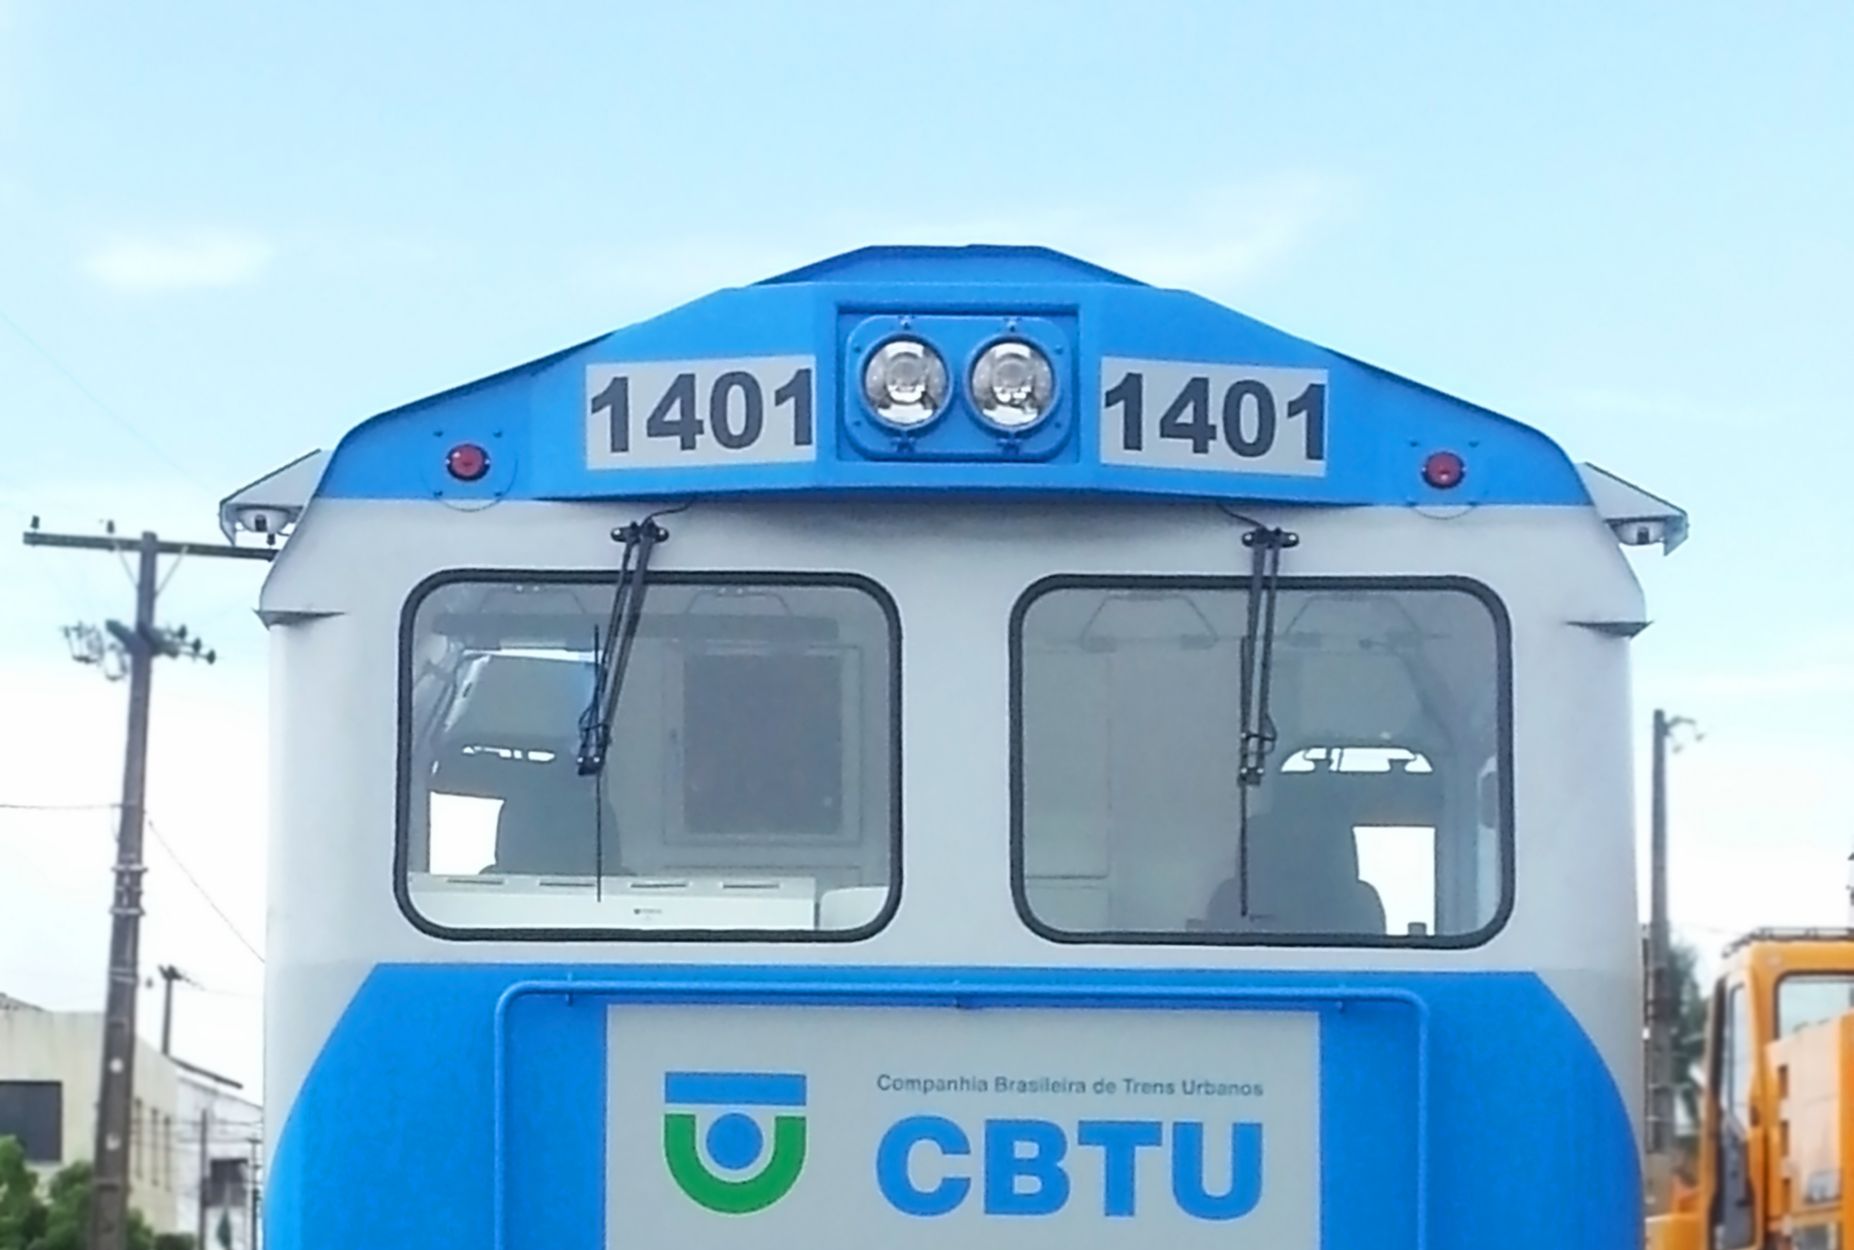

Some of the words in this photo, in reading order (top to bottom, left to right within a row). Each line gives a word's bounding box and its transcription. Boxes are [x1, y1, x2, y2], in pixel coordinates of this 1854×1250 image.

[590, 366, 814, 455] 1401
[1104, 369, 1326, 462] 1401
[876, 1073, 989, 1095] Companhia
[995, 1075, 1087, 1095] Brasileira
[1092, 1077, 1117, 1095] de
[1122, 1077, 1176, 1096] Trens
[1181, 1079, 1264, 1097] Urbanos
[875, 1114, 1264, 1221] CBTU
